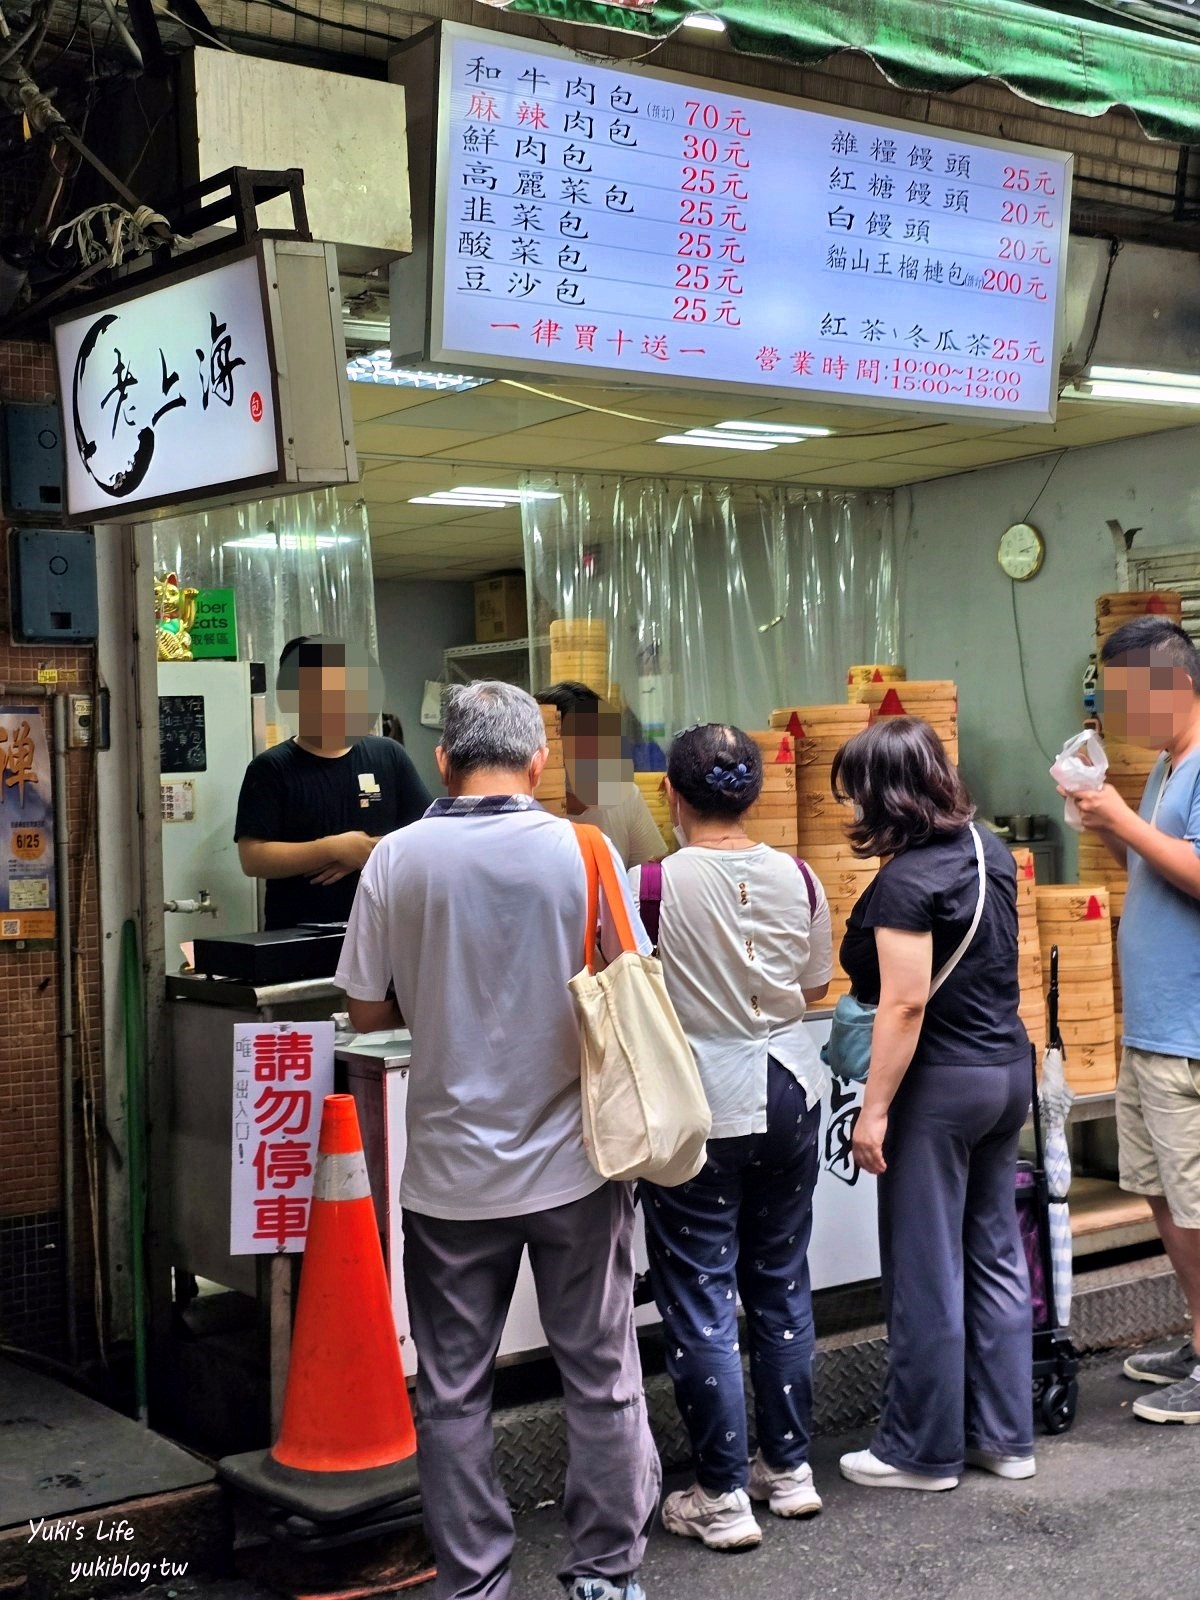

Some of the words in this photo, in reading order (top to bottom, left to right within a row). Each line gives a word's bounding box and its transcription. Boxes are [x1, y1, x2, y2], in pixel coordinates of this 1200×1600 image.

[465, 57, 639, 115] 和牛肉包
[685, 101, 751, 137] 70元
[464, 91, 637, 147] 麻辣肉包
[683, 135, 750, 168] 30元
[462, 125, 592, 173] 鮮肉包
[681, 167, 748, 200] 25元
[831, 130, 970, 179] 雜糧饅頭
[1002, 167, 1055, 195] 25元
[463, 161, 634, 214] 高麗菜包
[680, 199, 747, 232] 25元
[829, 166, 969, 214] 紅糖饅頭
[1001, 201, 1053, 228] 20元
[461, 196, 588, 239] 韭菜包
[678, 232, 745, 264] 25元
[827, 205, 930, 244] 白饅頭
[998, 237, 1051, 264] 20元
[459, 231, 586, 272] 酸菜包
[676, 265, 743, 295] 25元
[983, 268, 1047, 300] 200元
[457, 265, 585, 306] 豆沙包
[673, 296, 741, 326] 25元
[490, 318, 706, 361] 一律買十送一
[991, 338, 1044, 364] 25元
[252, 1032, 314, 1245] 請勿停車
